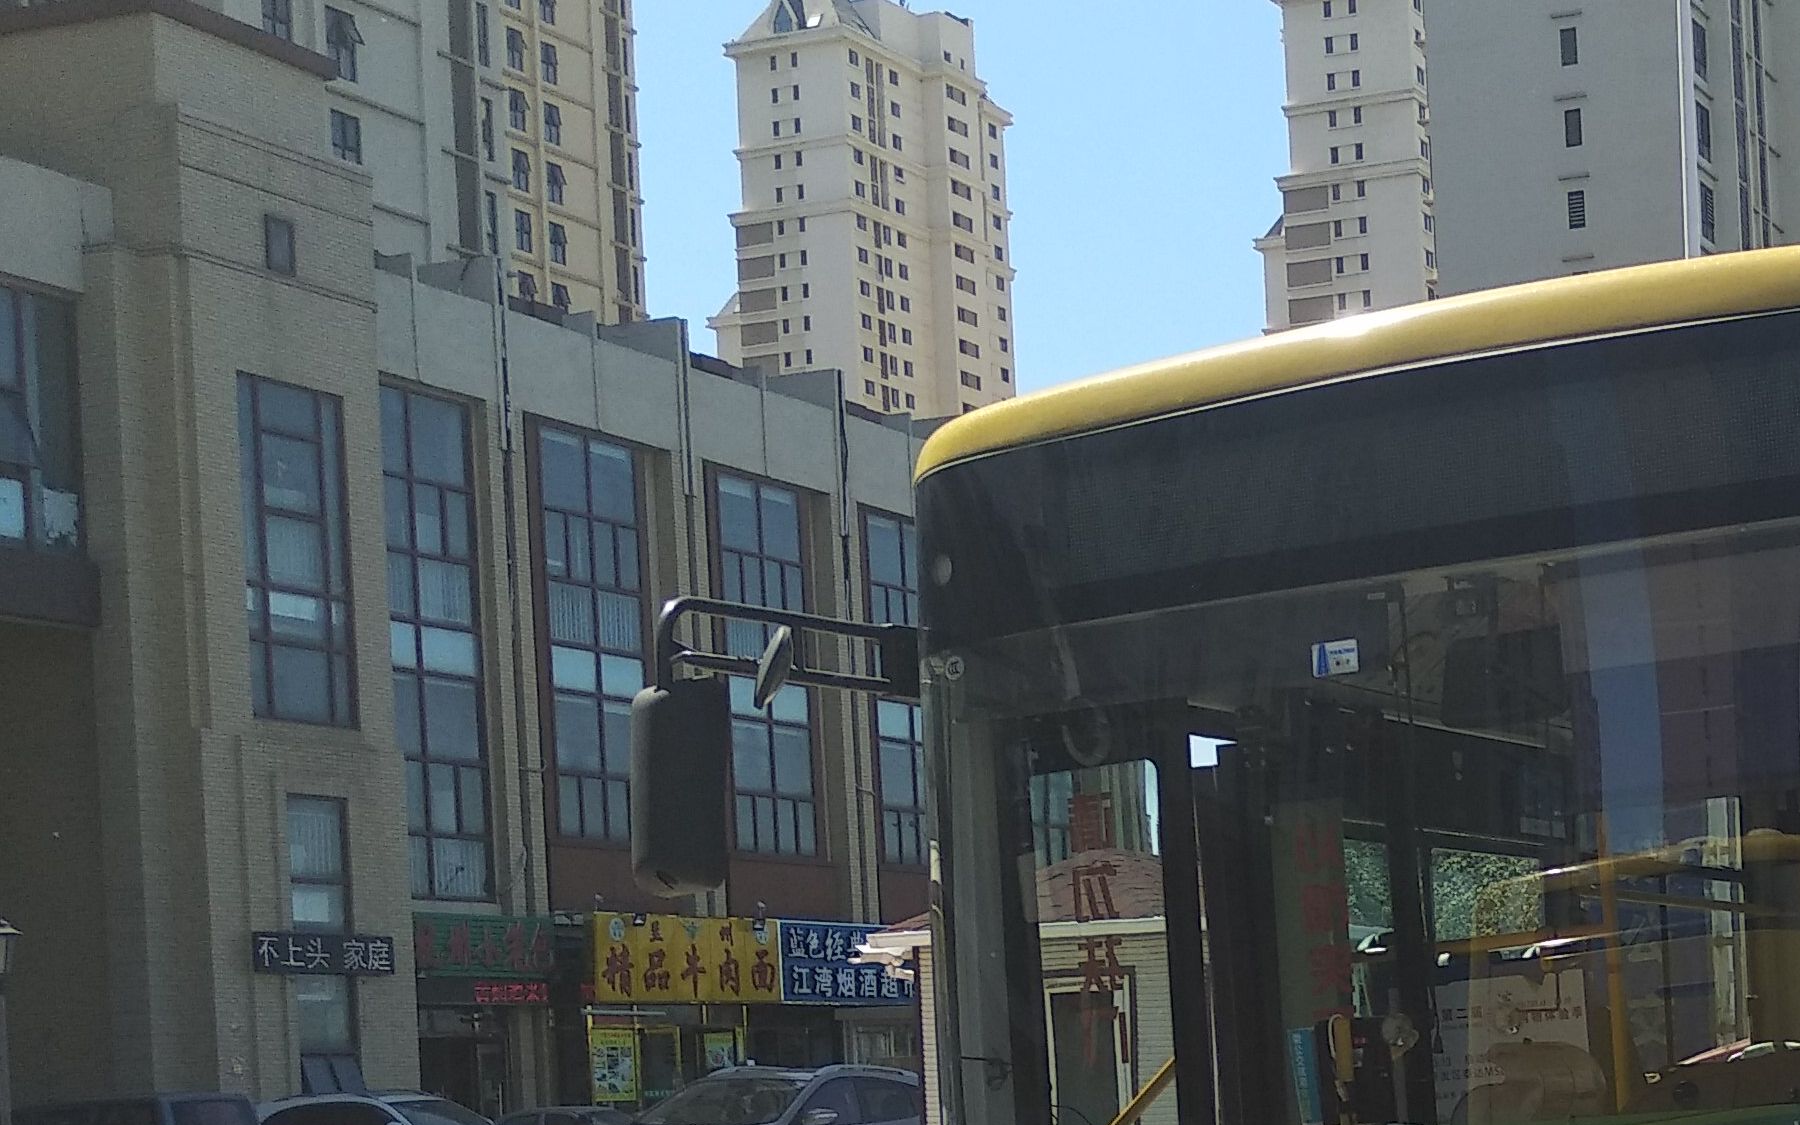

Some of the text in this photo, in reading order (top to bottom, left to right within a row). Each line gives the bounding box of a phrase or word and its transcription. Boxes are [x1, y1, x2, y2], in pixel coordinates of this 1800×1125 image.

[258, 936, 392, 971] 不上头 家庭
[602, 943, 776, 998] 精品牛肉面
